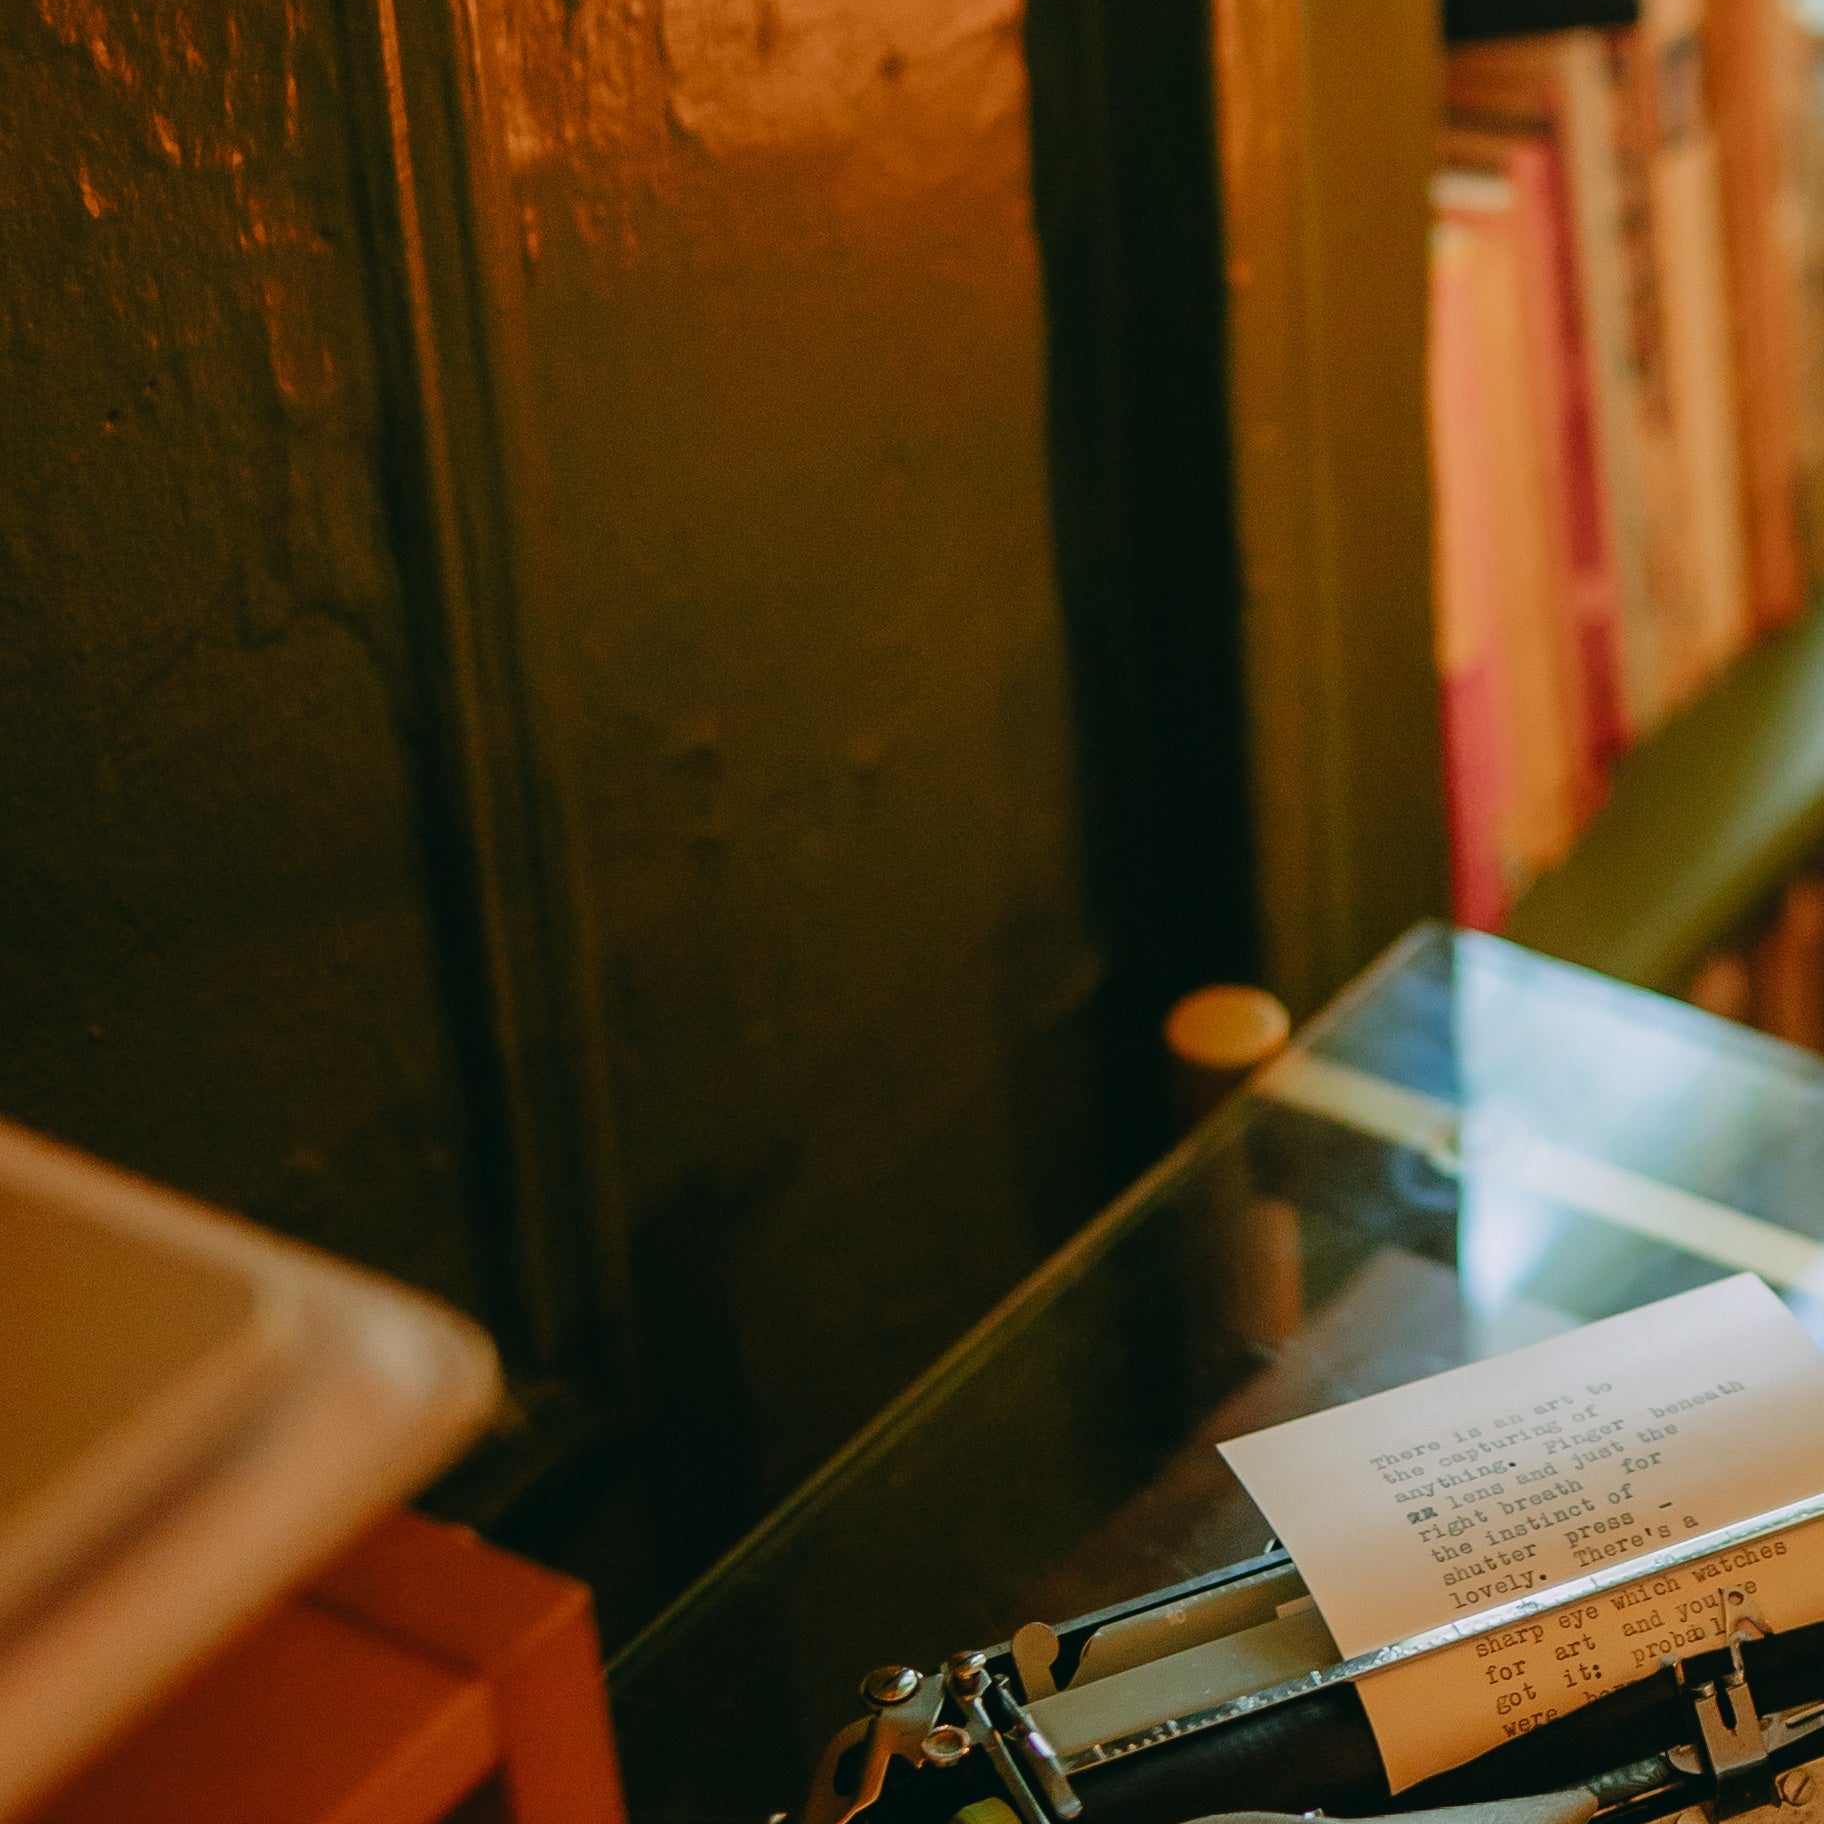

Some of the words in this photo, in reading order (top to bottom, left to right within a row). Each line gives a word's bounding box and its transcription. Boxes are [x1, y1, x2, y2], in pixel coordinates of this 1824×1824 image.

[1369, 1439, 1442, 1473] There
[1452, 1424, 1482, 1444] is
[1493, 1412, 1524, 1429] an
[1533, 1394, 1575, 1416] art
[1586, 1380, 1613, 1397] to
[1382, 1463, 1425, 1486] the
[1438, 1419, 1562, 1469] capturing
[1571, 1404, 1600, 1424] of
[1394, 1459, 1518, 1505] anything.
[1542, 1418, 1626, 1457] Finger
[1647, 1377, 1746, 1421] beneath
[1446, 1481, 1505, 1510] lens
[1515, 1461, 1559, 1486] and
[1571, 1439, 1625, 1471] just
[1636, 1422, 1680, 1444] the
[1417, 1508, 1489, 1543] right
[1497, 1478, 1585, 1517] breath
[1620, 1450, 1664, 1475] for
[1431, 1541, 1474, 1564] the
[1487, 1498, 1597, 1547] instinct
[1607, 1482, 1635, 1505] of
[1441, 1541, 1538, 1587] shutter
[1563, 1511, 1636, 1550] press
[1449, 1569, 1548, 1610] lovely.
[1572, 1521, 1672, 1569] There's
[1682, 1514, 1700, 1529] a
[1476, 1623, 1545, 1658] sharp
[1558, 1602, 1600, 1630] eye
[1609, 1574, 1682, 1612] which
[1691, 1539, 1788, 1584] watches
[1485, 1658, 1527, 1686] for
[1555, 1636, 1597, 1662] art
[1621, 1609, 1666, 1638] and
[1495, 1682, 1538, 1716] got
